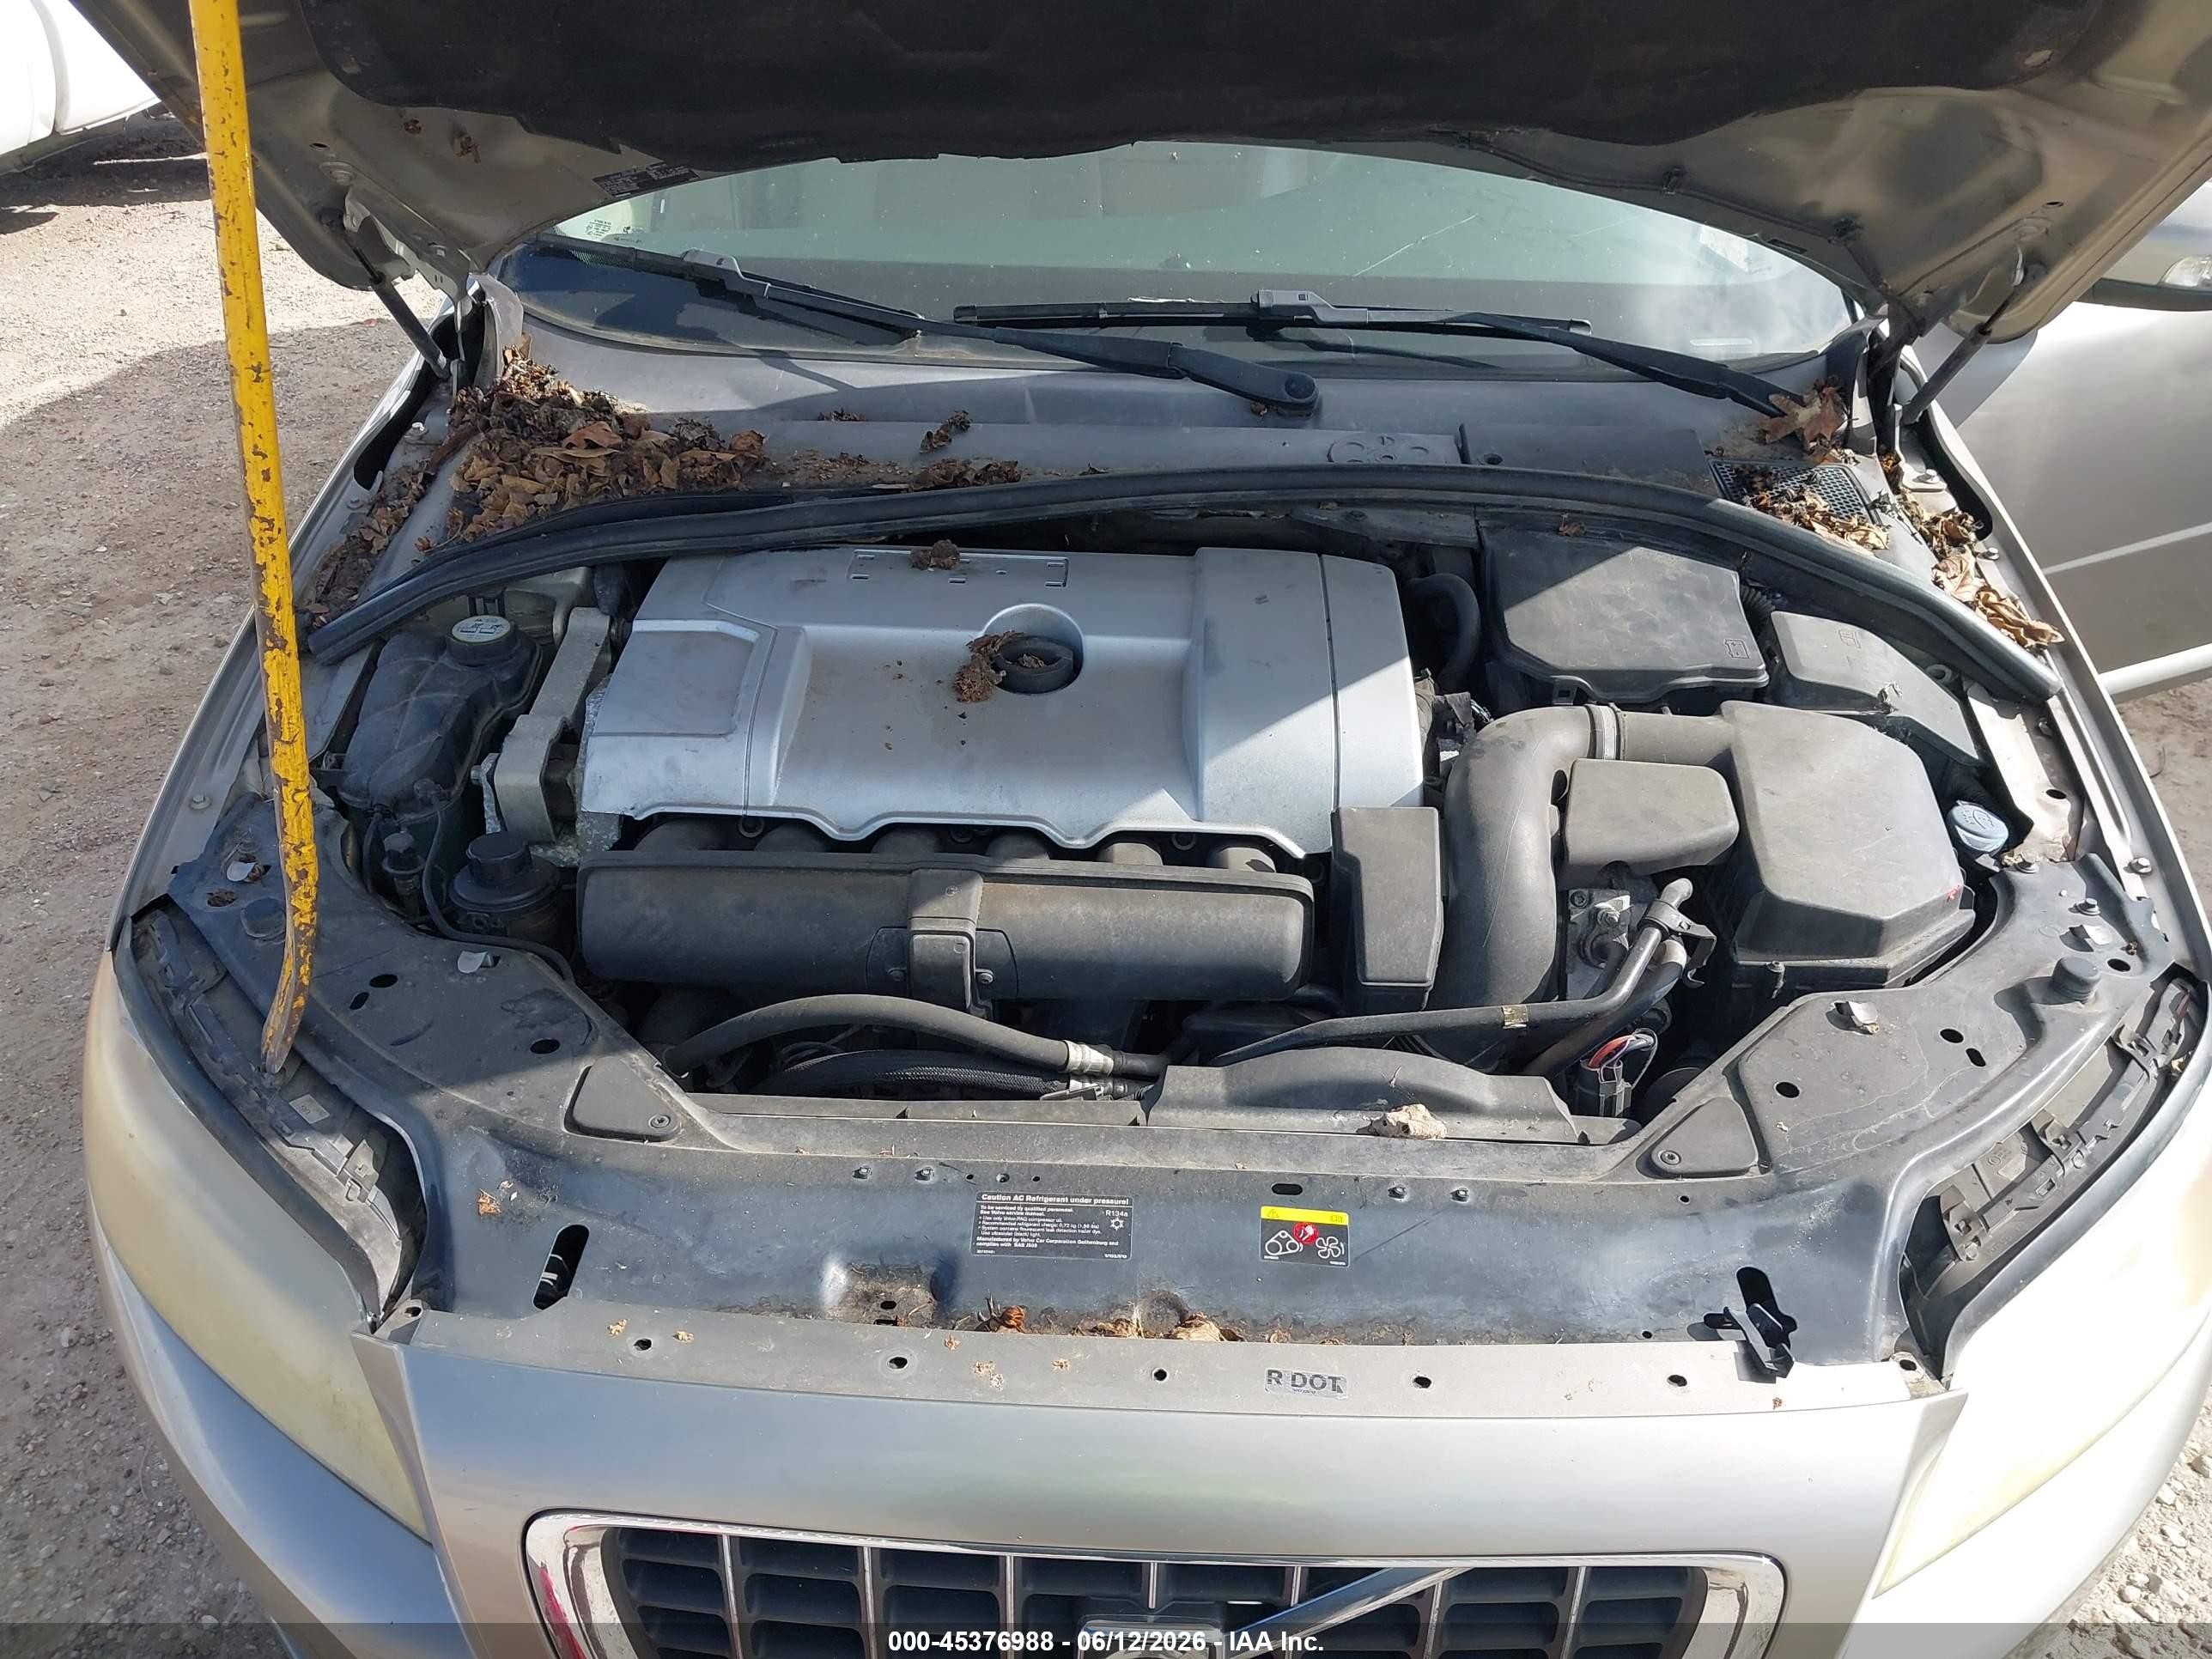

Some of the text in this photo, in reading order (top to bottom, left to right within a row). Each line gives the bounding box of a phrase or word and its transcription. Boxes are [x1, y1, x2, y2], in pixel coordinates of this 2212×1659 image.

[1026, 1194, 1068, 1203] Refrigerant
[1105, 1209, 1128, 1218] R134a
[1267, 1369, 1341, 1392] R DOT
